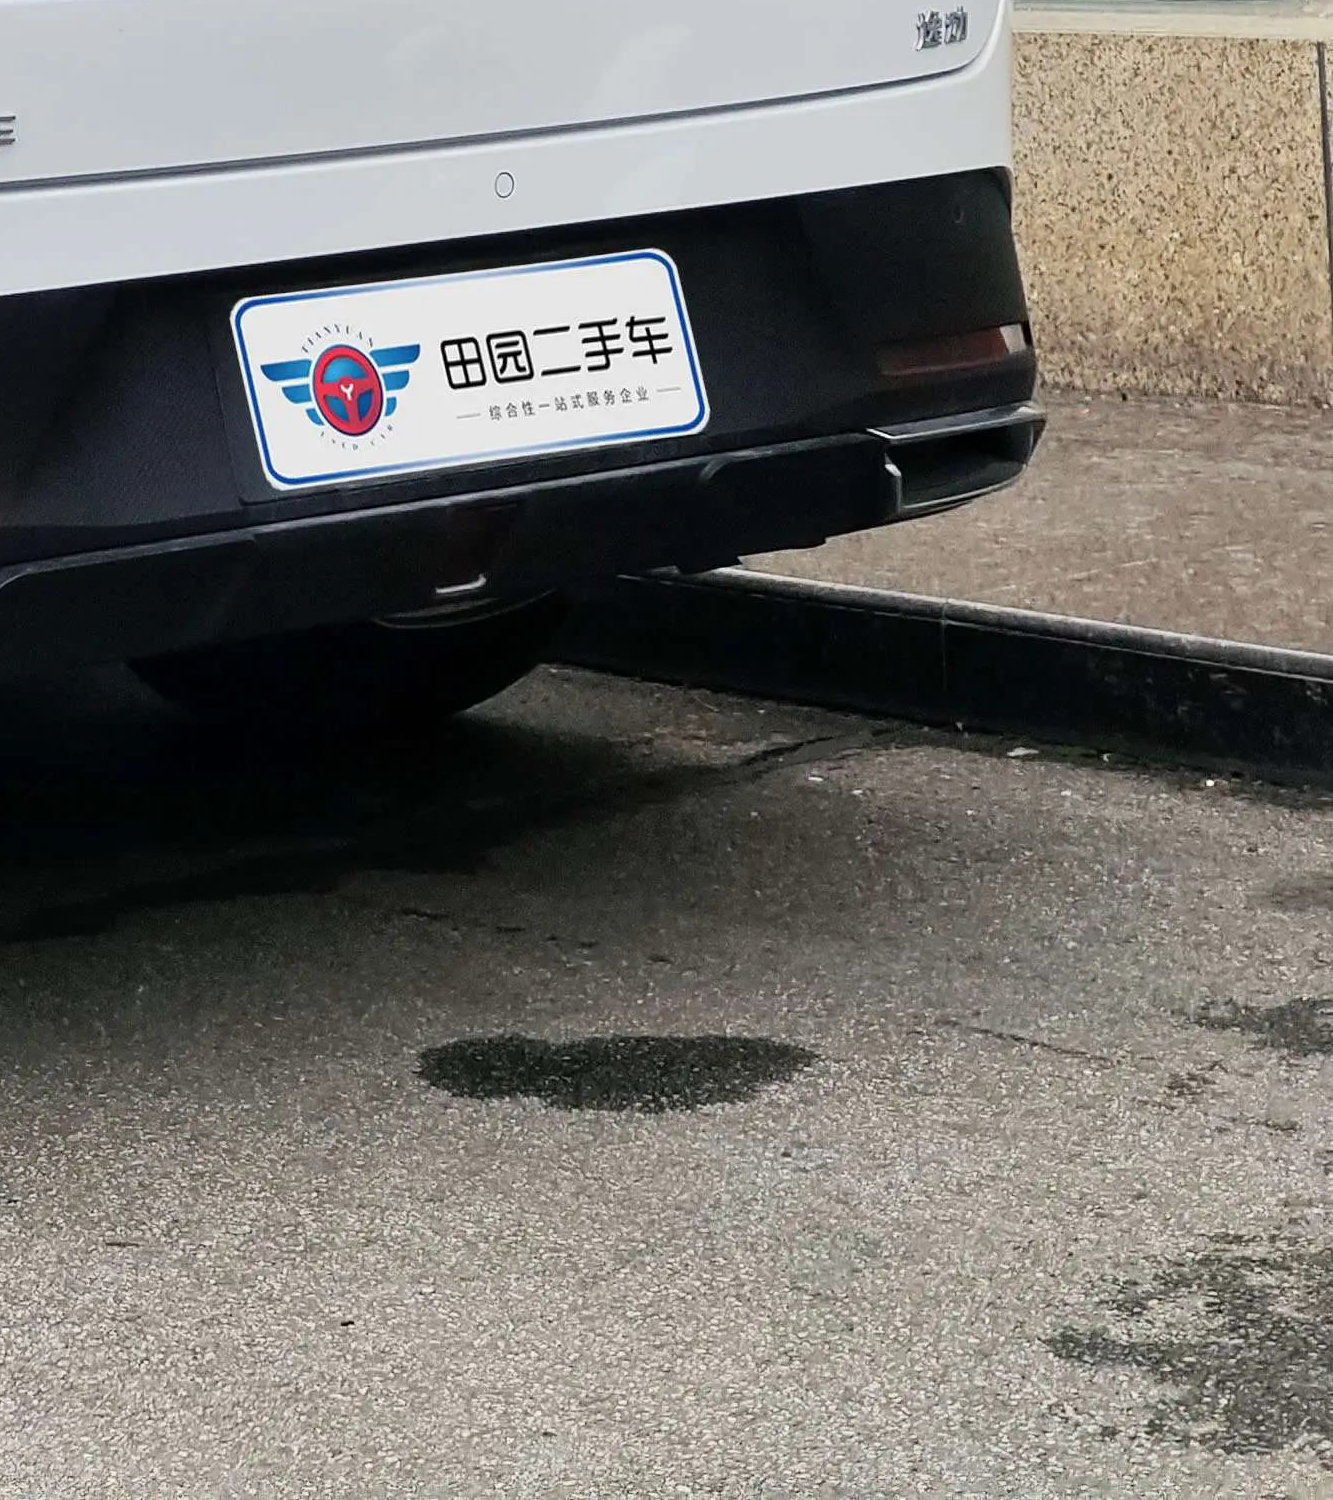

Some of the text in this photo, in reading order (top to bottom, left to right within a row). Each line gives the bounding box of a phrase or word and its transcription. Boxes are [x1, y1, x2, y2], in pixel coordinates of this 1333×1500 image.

[440, 315, 674, 390] 田园二手车
[488, 386, 650, 422] 综合性一站式服务企业
